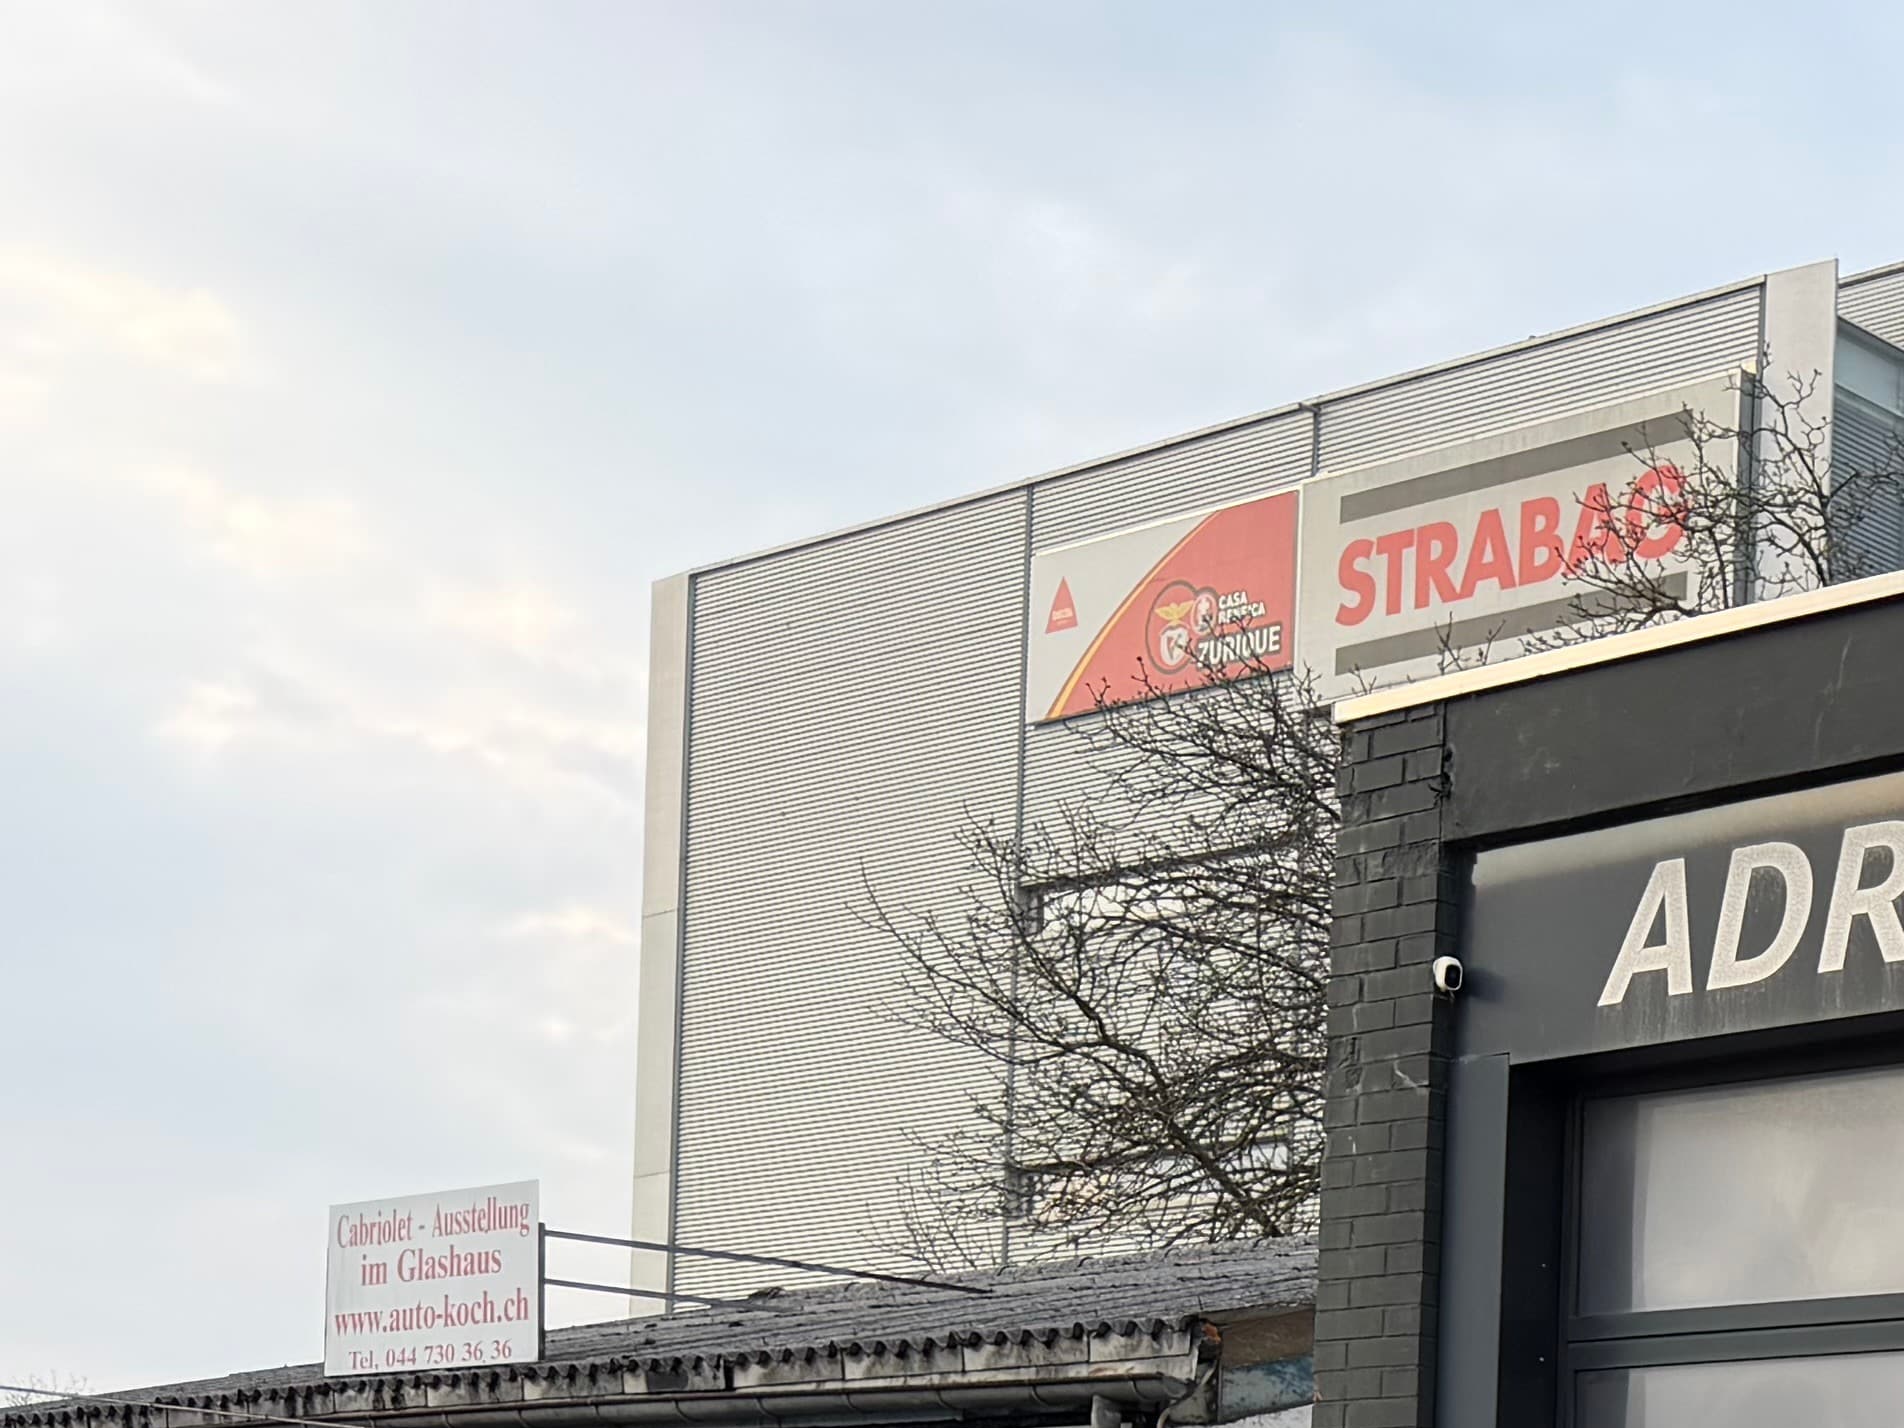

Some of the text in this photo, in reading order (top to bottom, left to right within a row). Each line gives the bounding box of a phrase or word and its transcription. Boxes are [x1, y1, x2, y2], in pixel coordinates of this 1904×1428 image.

[1335, 464, 1690, 627] STRABAG
[1218, 591, 1248, 609] CASA
[336, 1208, 413, 1248] Cabriolet
[432, 1196, 531, 1237] Ausstellung
[361, 1244, 502, 1286] im Glashaus
[335, 1287, 530, 1336] www.auto-koch.ch
[386, 1347, 417, 1367] 044
[424, 1344, 455, 1364] 730
[462, 1341, 483, 1361] 36
[491, 1339, 512, 1359] 36
